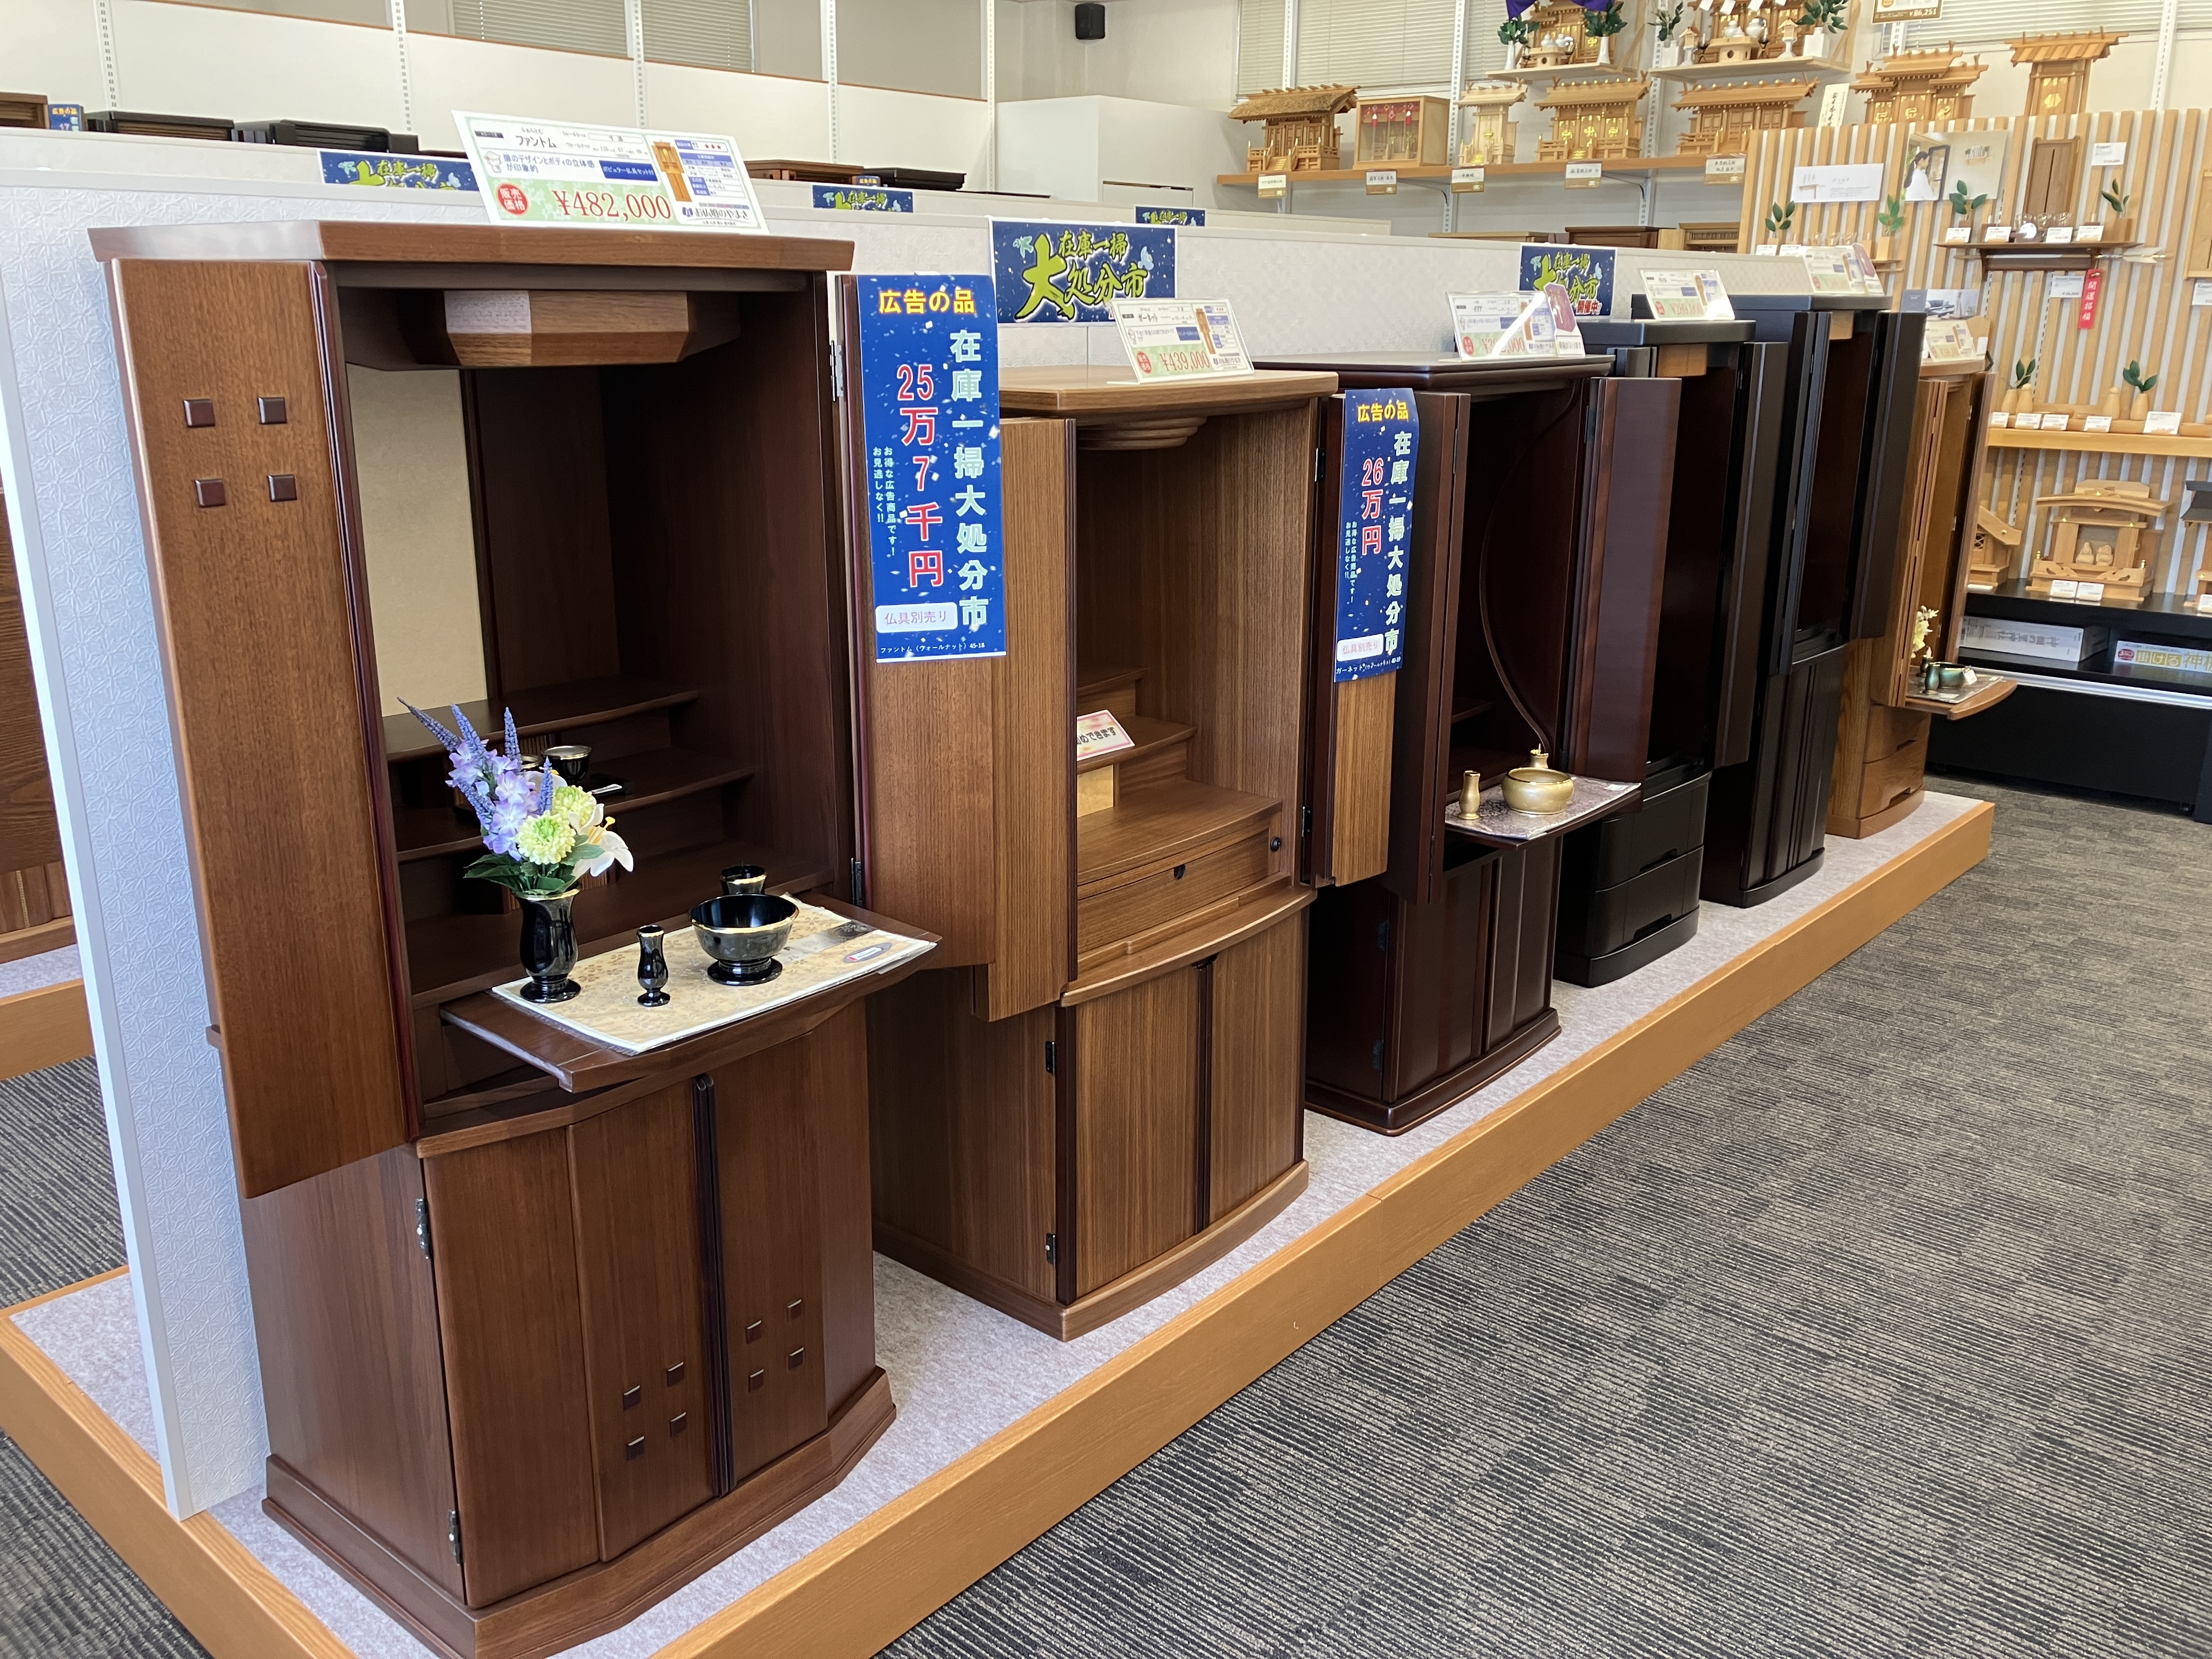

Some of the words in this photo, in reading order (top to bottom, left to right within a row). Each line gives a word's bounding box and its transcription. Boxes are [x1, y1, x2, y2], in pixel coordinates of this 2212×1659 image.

[515, 135, 557, 149] ファントム
[506, 164, 539, 174] が印象的
[552, 190, 672, 222] ¥482,000
[1058, 229, 1128, 261] 在庫一掃
[879, 289, 975, 314] 広告の品
[1357, 402, 1409, 423] 広告の品
[950, 329, 989, 626] 在庫一掃大処分市
[1385, 431, 1412, 652] 在庫一掃大処分市
[884, 611, 947, 625] 仏具別売り
[1342, 642, 1378, 654] 仏具別売り
